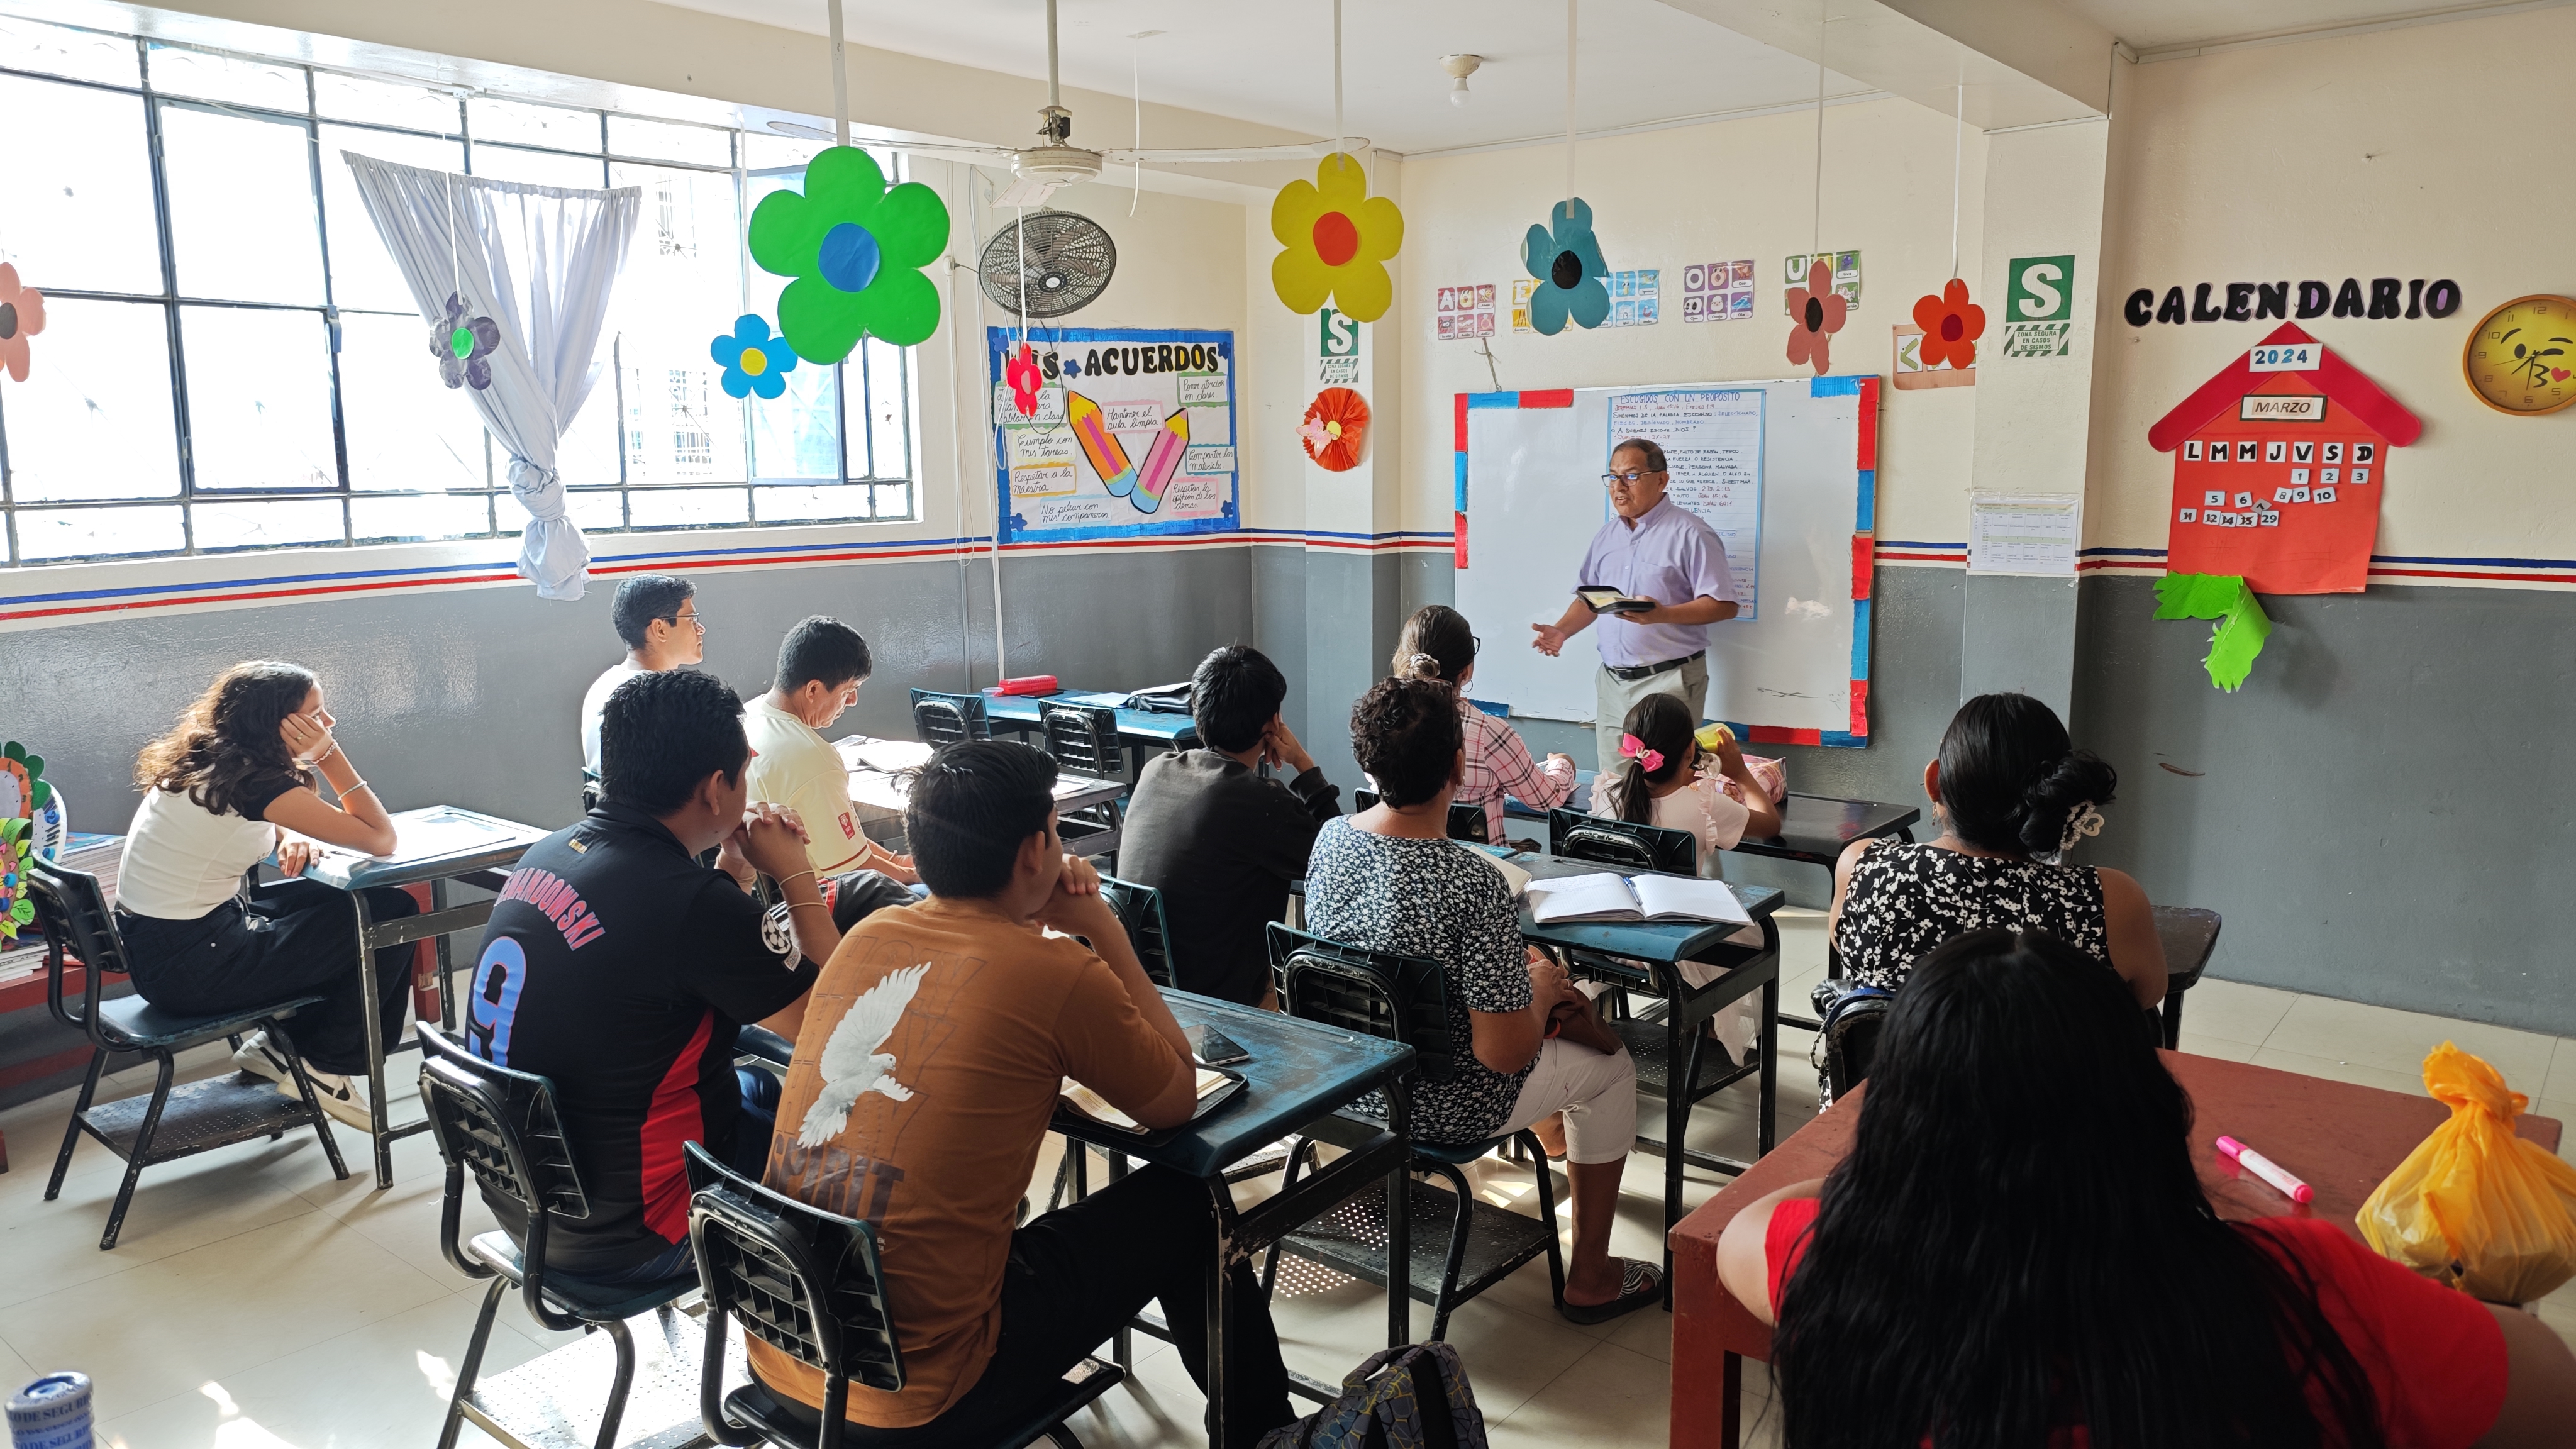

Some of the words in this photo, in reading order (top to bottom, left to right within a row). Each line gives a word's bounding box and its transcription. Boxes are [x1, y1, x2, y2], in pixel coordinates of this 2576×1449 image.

[1787, 258, 1806, 281] U
[1686, 269, 1704, 289] O
[1514, 281, 1529, 303] E
[2019, 264, 2062, 318] S
[1439, 289, 1454, 310] A
[2124, 278, 2463, 328] CALENDARIO
[1327, 312, 1353, 354] S
[1084, 343, 1218, 377] ACUERDOS
[2255, 349, 2308, 364] 2024
[1184, 378, 1199, 391] Poner
[1038, 390, 1051, 401] la
[1185, 392, 1194, 400] en
[1620, 394, 1659, 404] ESCOGIDOS
[1665, 394, 1679, 402] CON
[1685, 393, 1695, 402] UN
[1107, 407, 1143, 420] Mantener
[1143, 406, 1153, 417] el
[2255, 401, 2311, 413] MARZO
[1107, 419, 1126, 430] aula
[1018, 434, 1053, 449] Cumplo
[1020, 448, 1036, 457] mis
[1188, 448, 1222, 462] Compartir
[1223, 448, 1233, 458] los
[2187, 443, 2200, 458] L
[2211, 443, 2228, 460] M
[2239, 443, 2256, 460] M
[2269, 445, 2282, 460] J
[2295, 445, 2312, 461] V
[2326, 445, 2339, 462] S
[2356, 445, 2372, 462] D
[1014, 469, 1048, 485] Respetar
[1060, 467, 1073, 477] la
[2297, 473, 2302, 481] 1
[2326, 472, 2333, 481] 2
[2356, 472, 2363, 481] 3
[1173, 483, 1199, 494] Respetar
[1202, 482, 1211, 492] la
[1196, 492, 1202, 501] de
[1203, 491, 1216, 500] los
[2279, 492, 2287, 500] 8
[2297, 491, 2305, 499] 9
[2317, 491, 2331, 501] 10
[1041, 503, 1055, 515] No
[1042, 514, 1058, 525] mis
[2262, 514, 2277, 523] 29
[762, 1133, 906, 1228] SPIRIT
